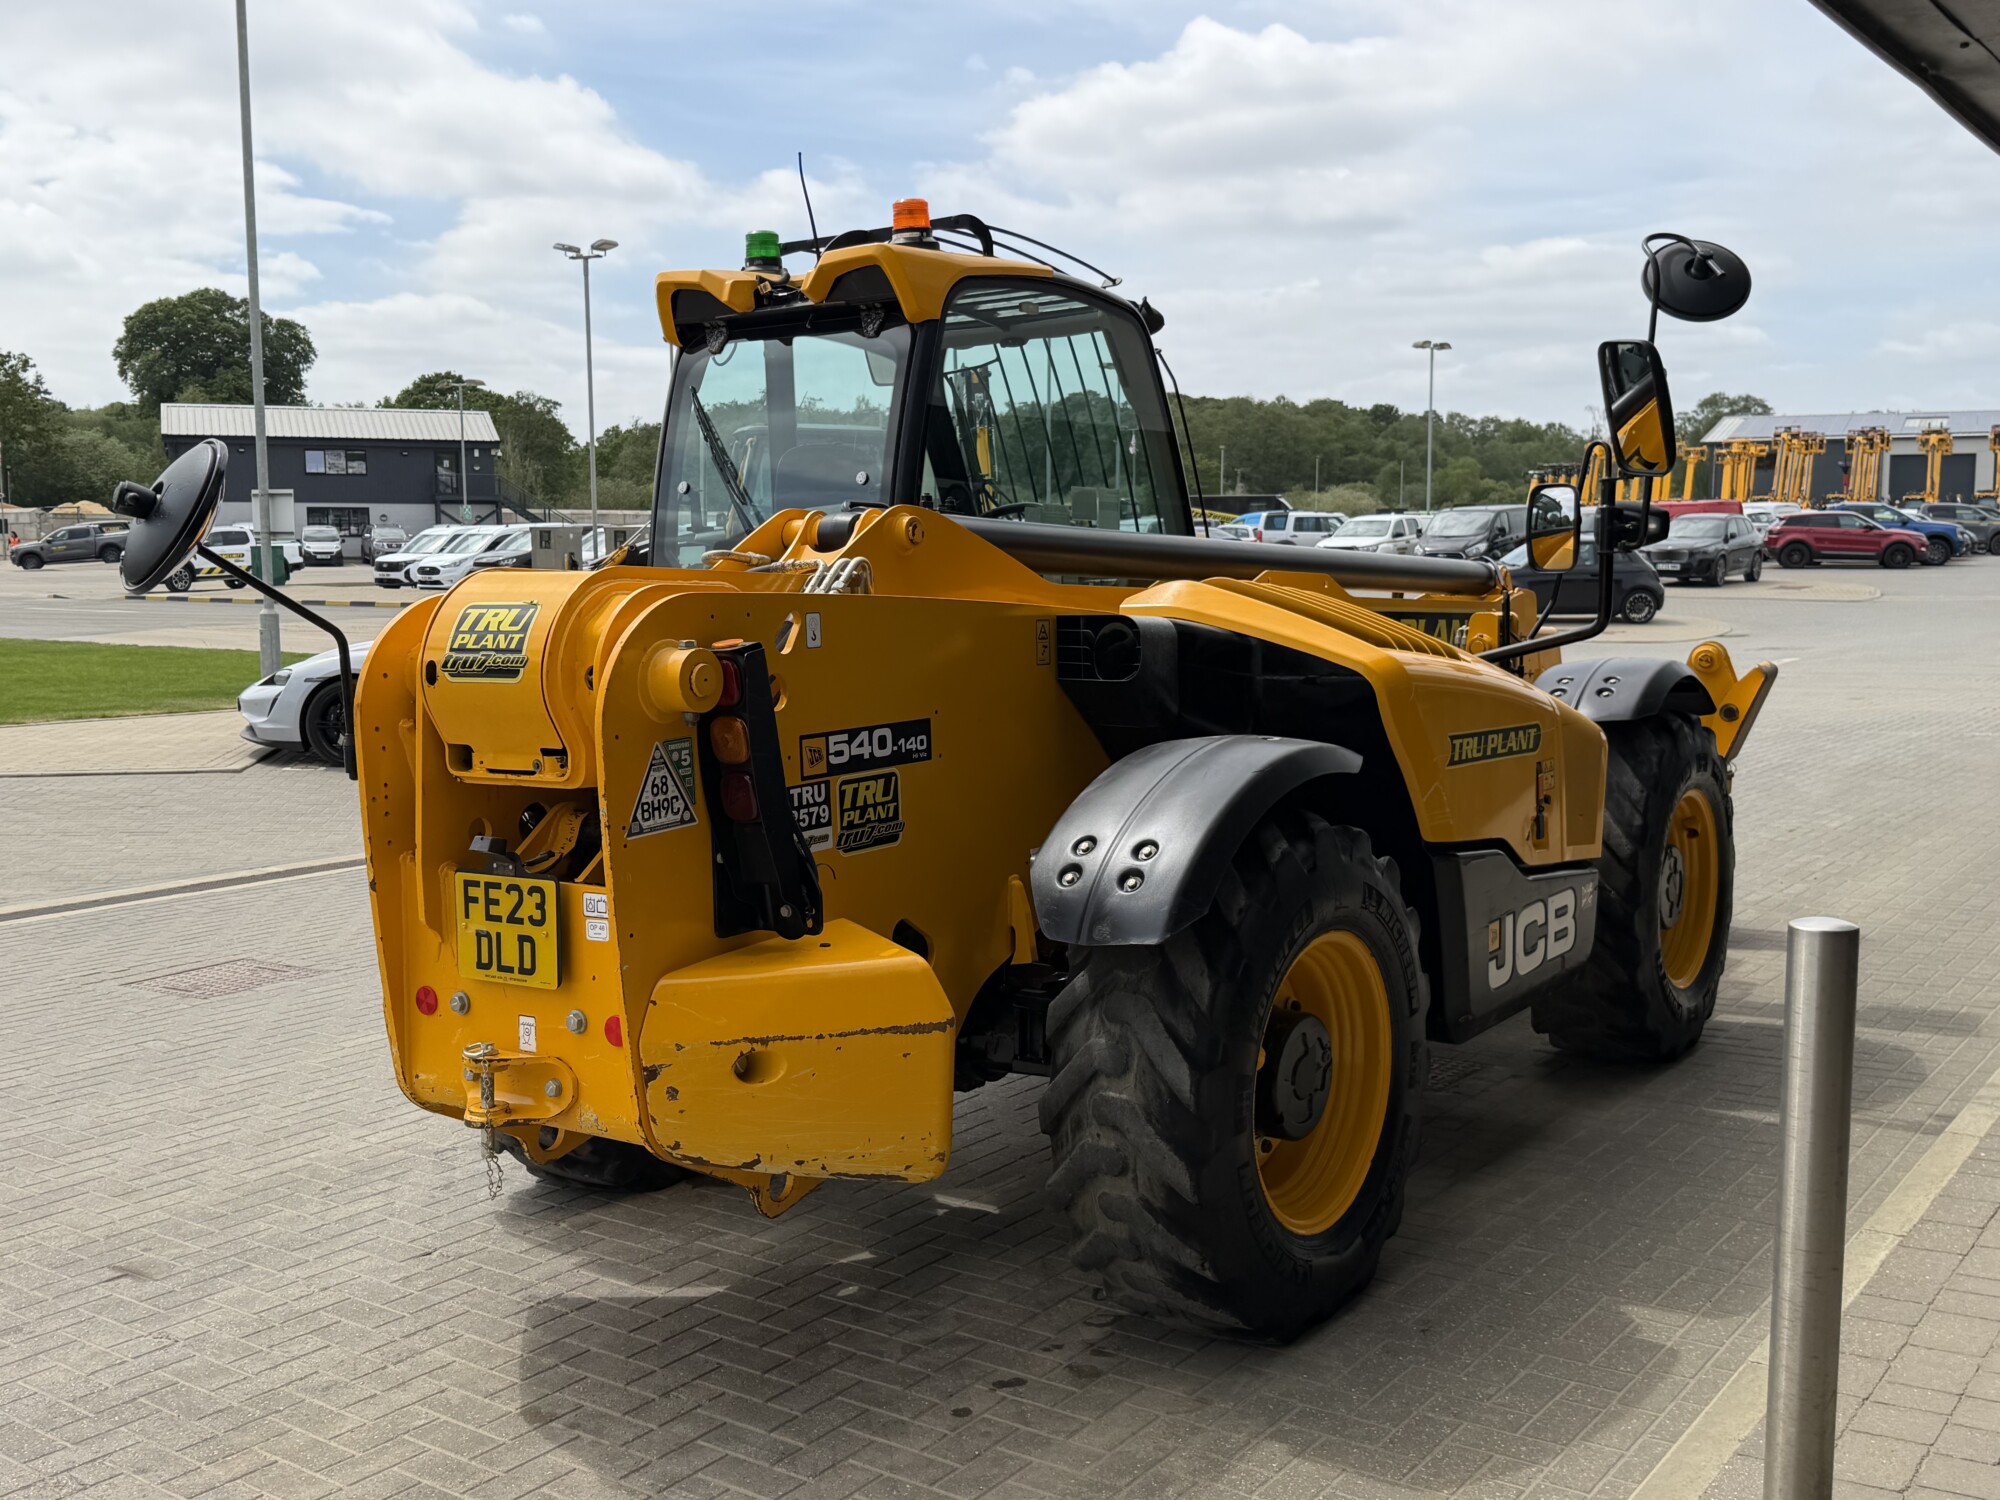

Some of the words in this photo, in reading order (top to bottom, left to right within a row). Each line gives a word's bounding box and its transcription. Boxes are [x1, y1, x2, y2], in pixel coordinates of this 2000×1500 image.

[459, 608, 535, 632] TRU
[452, 634, 525, 649] PLANT
[441, 652, 528, 673] tru7.com
[681, 749, 691, 766] 5
[1453, 736, 1484, 761] TRU
[1486, 728, 1537, 756] PLANT
[651, 775, 669, 797] 68
[790, 783, 826, 807] TRU
[841, 776, 896, 810] TRU
[641, 795, 681, 822] BH9C
[842, 802, 897, 827] PLANT
[836, 820, 906, 850] tru7.com
[463, 879, 547, 927] FE23
[1488, 888, 1576, 990] JCB
[476, 929, 536, 976] DLD
